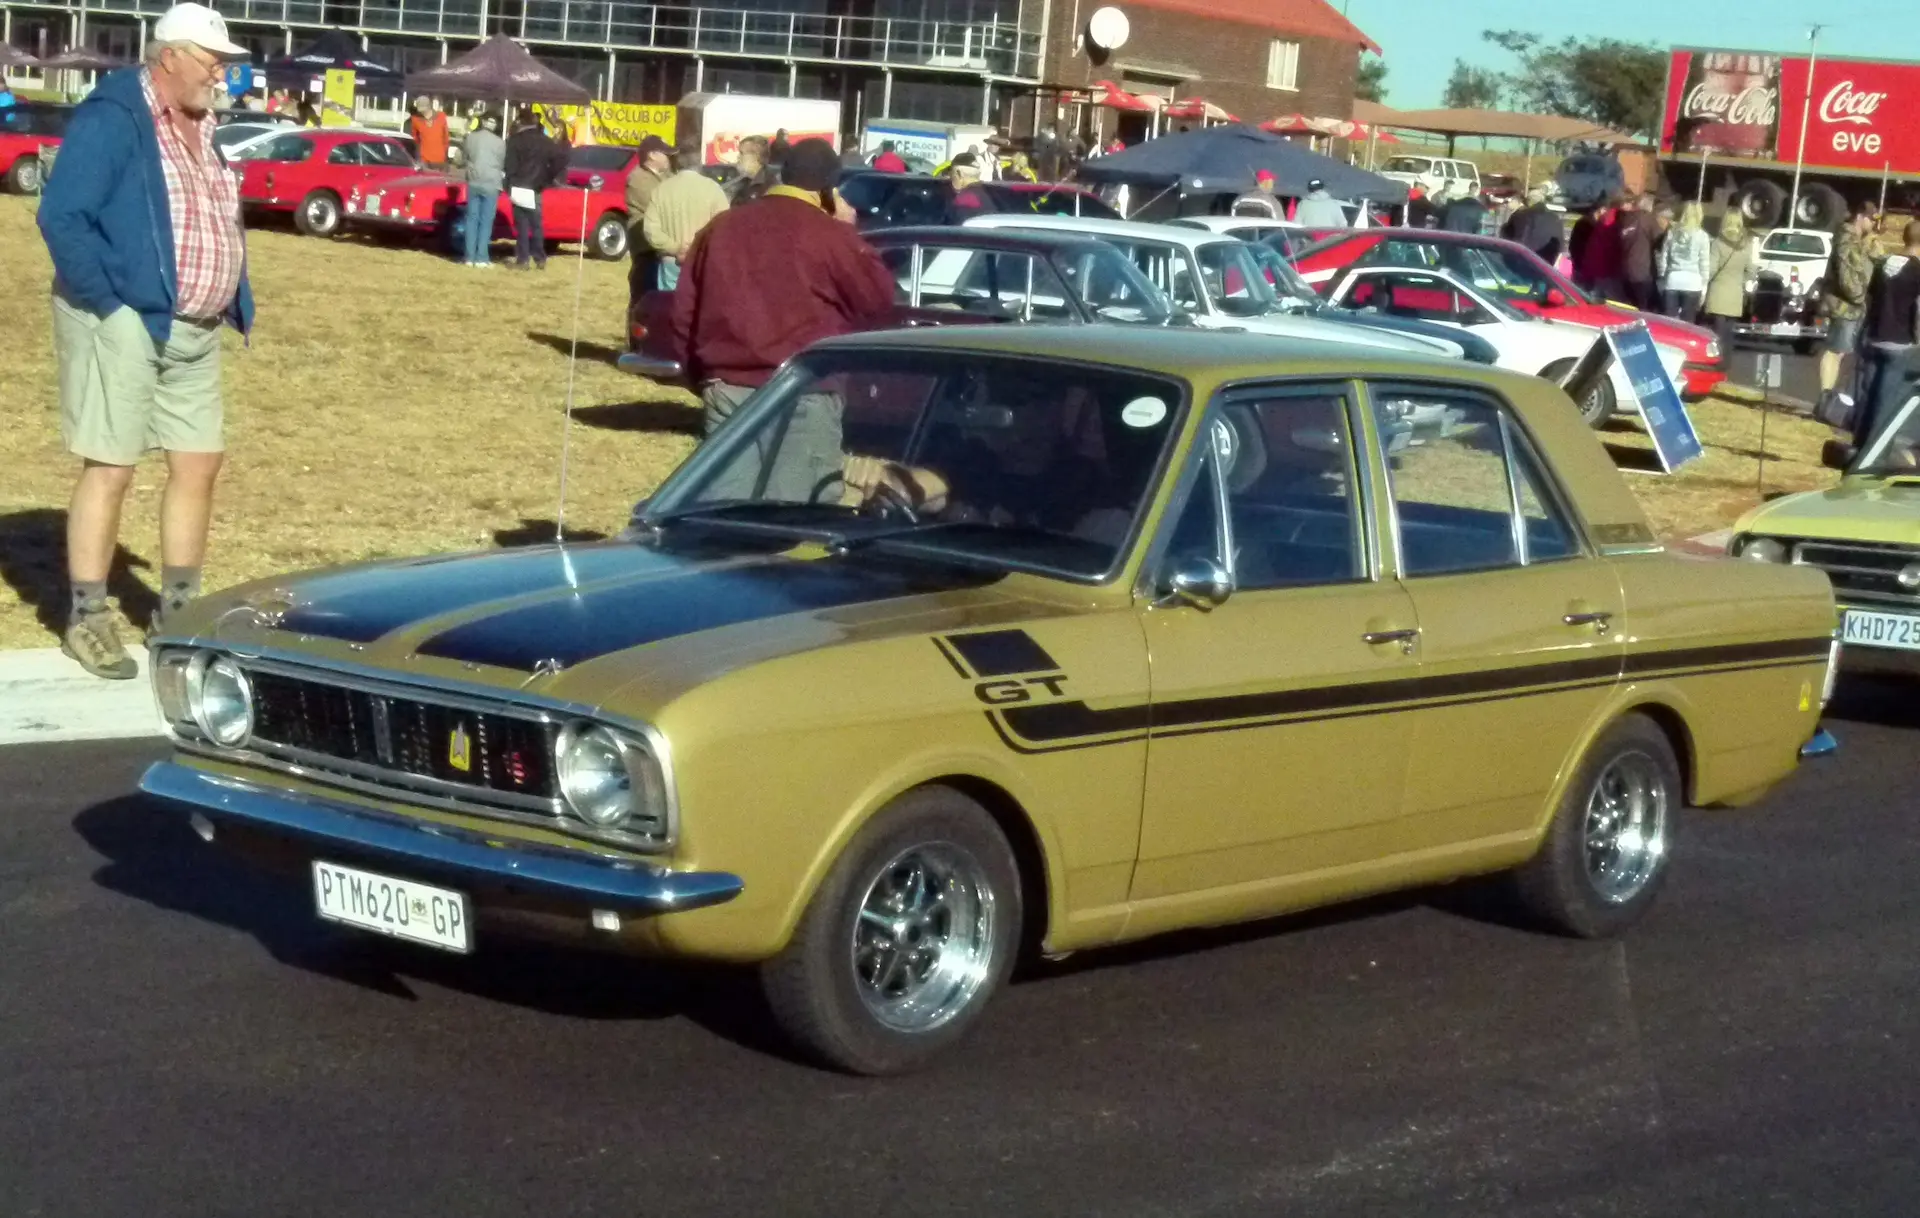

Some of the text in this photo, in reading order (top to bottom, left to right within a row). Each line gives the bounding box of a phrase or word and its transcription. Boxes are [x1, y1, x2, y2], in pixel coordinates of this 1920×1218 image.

[615, 110, 650, 124] CLUB
[653, 111, 671, 124] OF
[1832, 131, 1881, 153] eve
[974, 674, 1068, 705] GT
[320, 868, 461, 939] PTM620 GP
